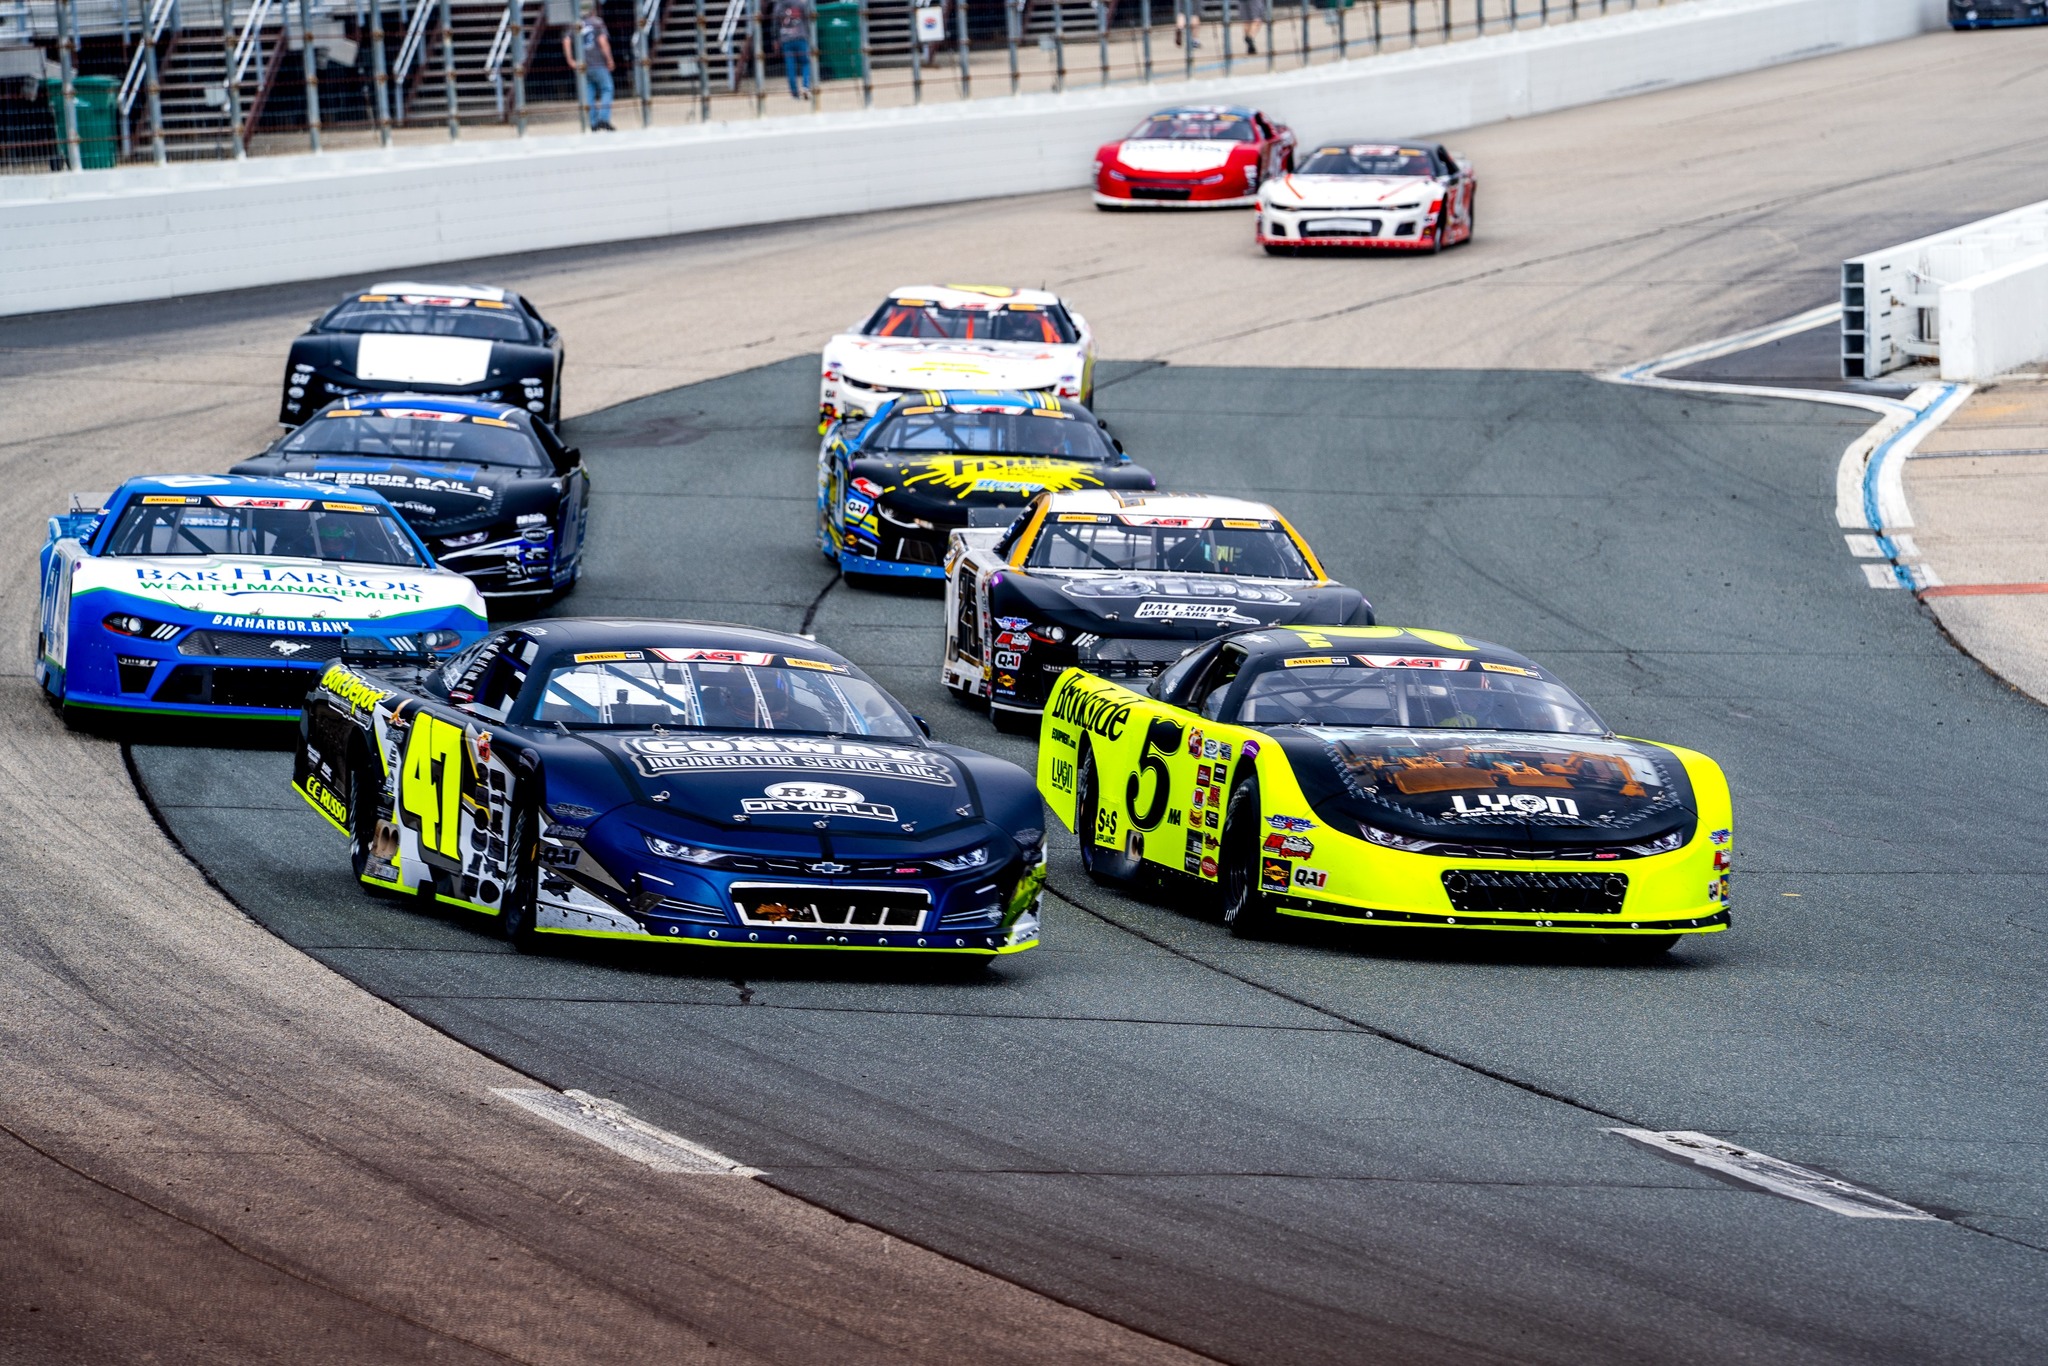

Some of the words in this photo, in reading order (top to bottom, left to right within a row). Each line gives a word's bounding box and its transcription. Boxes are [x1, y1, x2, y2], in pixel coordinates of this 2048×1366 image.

[284, 472, 408, 484] SUPERIOR
[414, 477, 471, 491] RAIL
[477, 485, 494, 497] &
[233, 498, 292, 508] ACT
[848, 501, 867, 514] QA1
[1141, 517, 1194, 527] ACT
[136, 568, 222, 581] BAR
[234, 568, 424, 594] HARBOR
[140, 581, 237, 591] WEALTH
[247, 583, 424, 603] MANAGEMENT
[1142, 602, 1180, 612] DALE
[1186, 605, 1233, 614] SHAW
[212, 614, 354, 633] BARHARBOR.BANK
[583, 652, 618, 660] Milton
[682, 650, 751, 663] ACT
[793, 659, 826, 669] Milton
[998, 654, 1020, 667] QA1
[1385, 657, 1448, 669] ACT
[1489, 664, 1520, 673] Milton
[1052, 673, 1144, 741] Brookside
[643, 740, 917, 762] CONWAY
[650, 756, 796, 768] INCINERATOR
[801, 757, 893, 773] SERVICE
[896, 763, 943, 779] INC.
[1125, 716, 1186, 832] 5
[403, 711, 463, 861] 47
[778, 787, 807, 797] R
[821, 789, 848, 799] B
[319, 787, 347, 824] RUSSO
[745, 800, 895, 818] DRYWALL
[1097, 807, 1118, 836] S&S
[1166, 808, 1181, 826] MA
[543, 846, 581, 866] QA1
[1294, 868, 1327, 888] QA1
